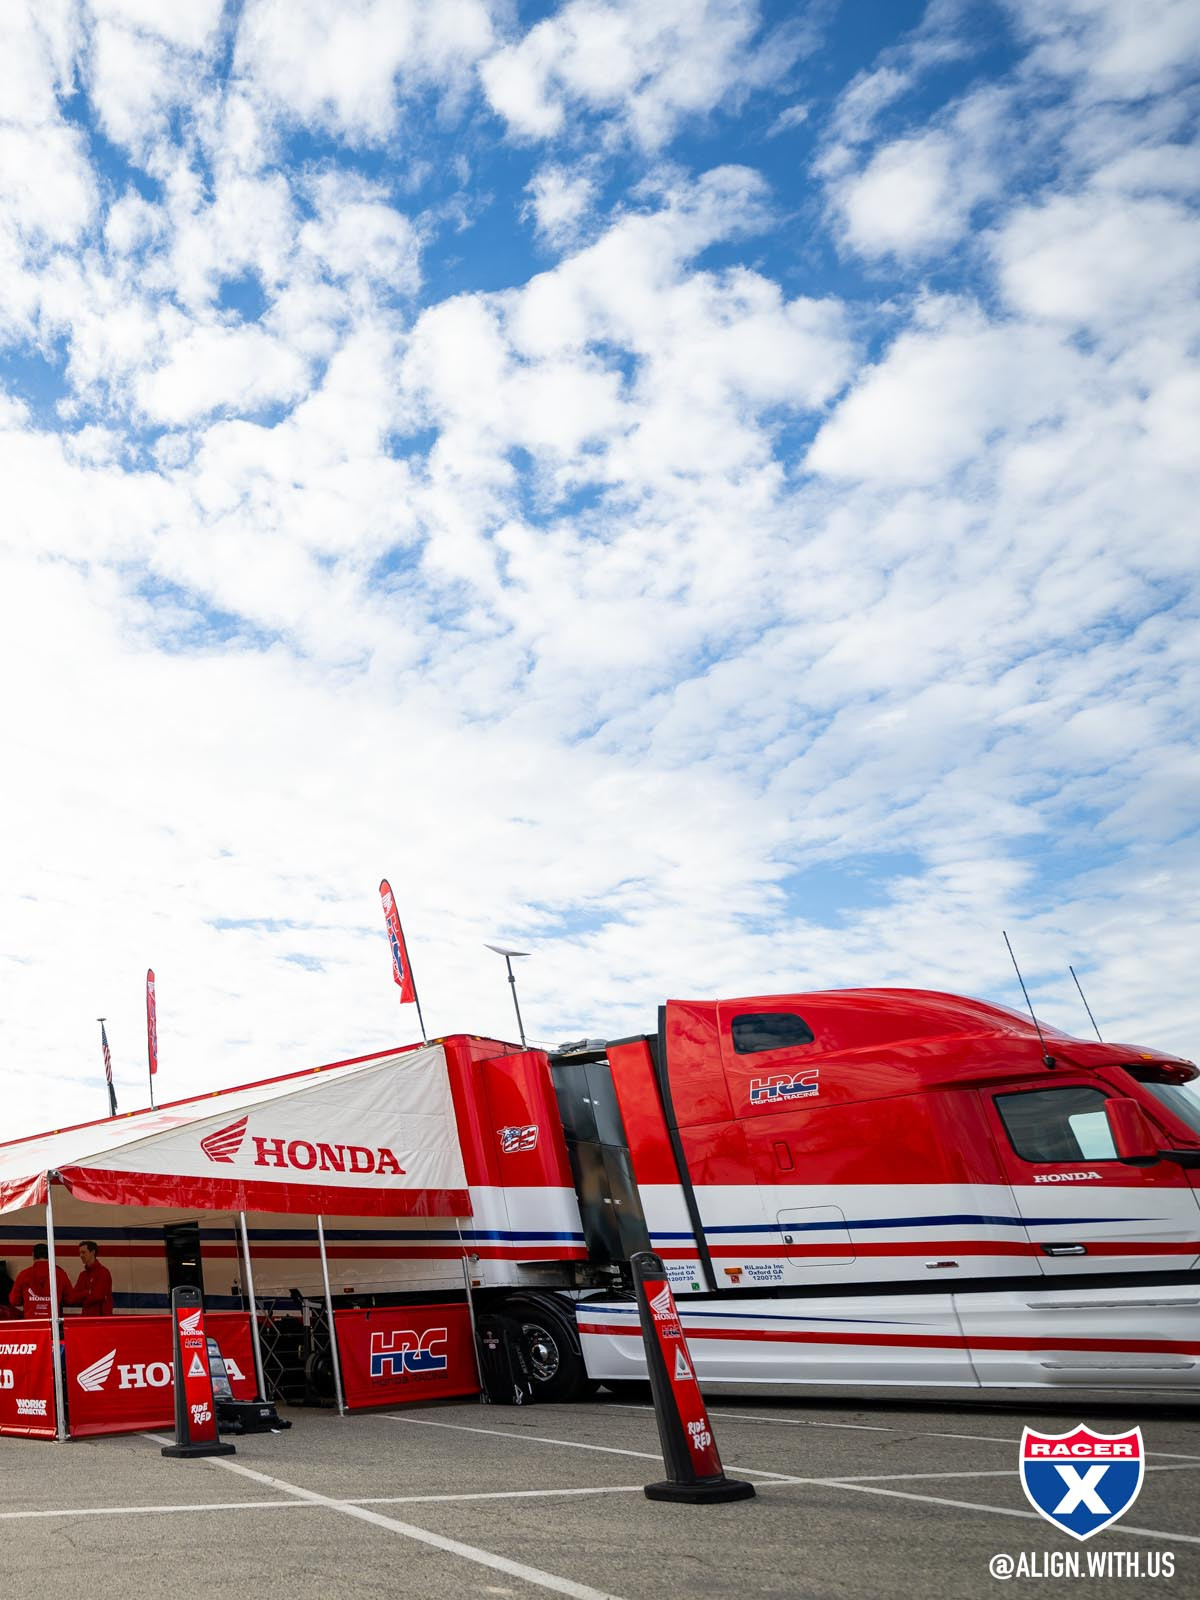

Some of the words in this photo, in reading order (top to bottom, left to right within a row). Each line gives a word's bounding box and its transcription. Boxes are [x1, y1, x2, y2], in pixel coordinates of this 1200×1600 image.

[750, 1069, 819, 1101] HRC
[751, 1097, 783, 1105] Honda
[784, 1091, 819, 1101] RACING
[498, 1125, 538, 1154] 69
[252, 1136, 406, 1175] HONDA
[1033, 1171, 1103, 1183] HONDA
[370, 1327, 447, 1377] HRC
[117, 1358, 246, 1389] HOA
[15, 1398, 47, 1409] WORKS
[191, 1402, 208, 1414] RIDE
[193, 1411, 212, 1424] RED
[687, 1418, 706, 1435] RIDE
[692, 1432, 711, 1452] RED
